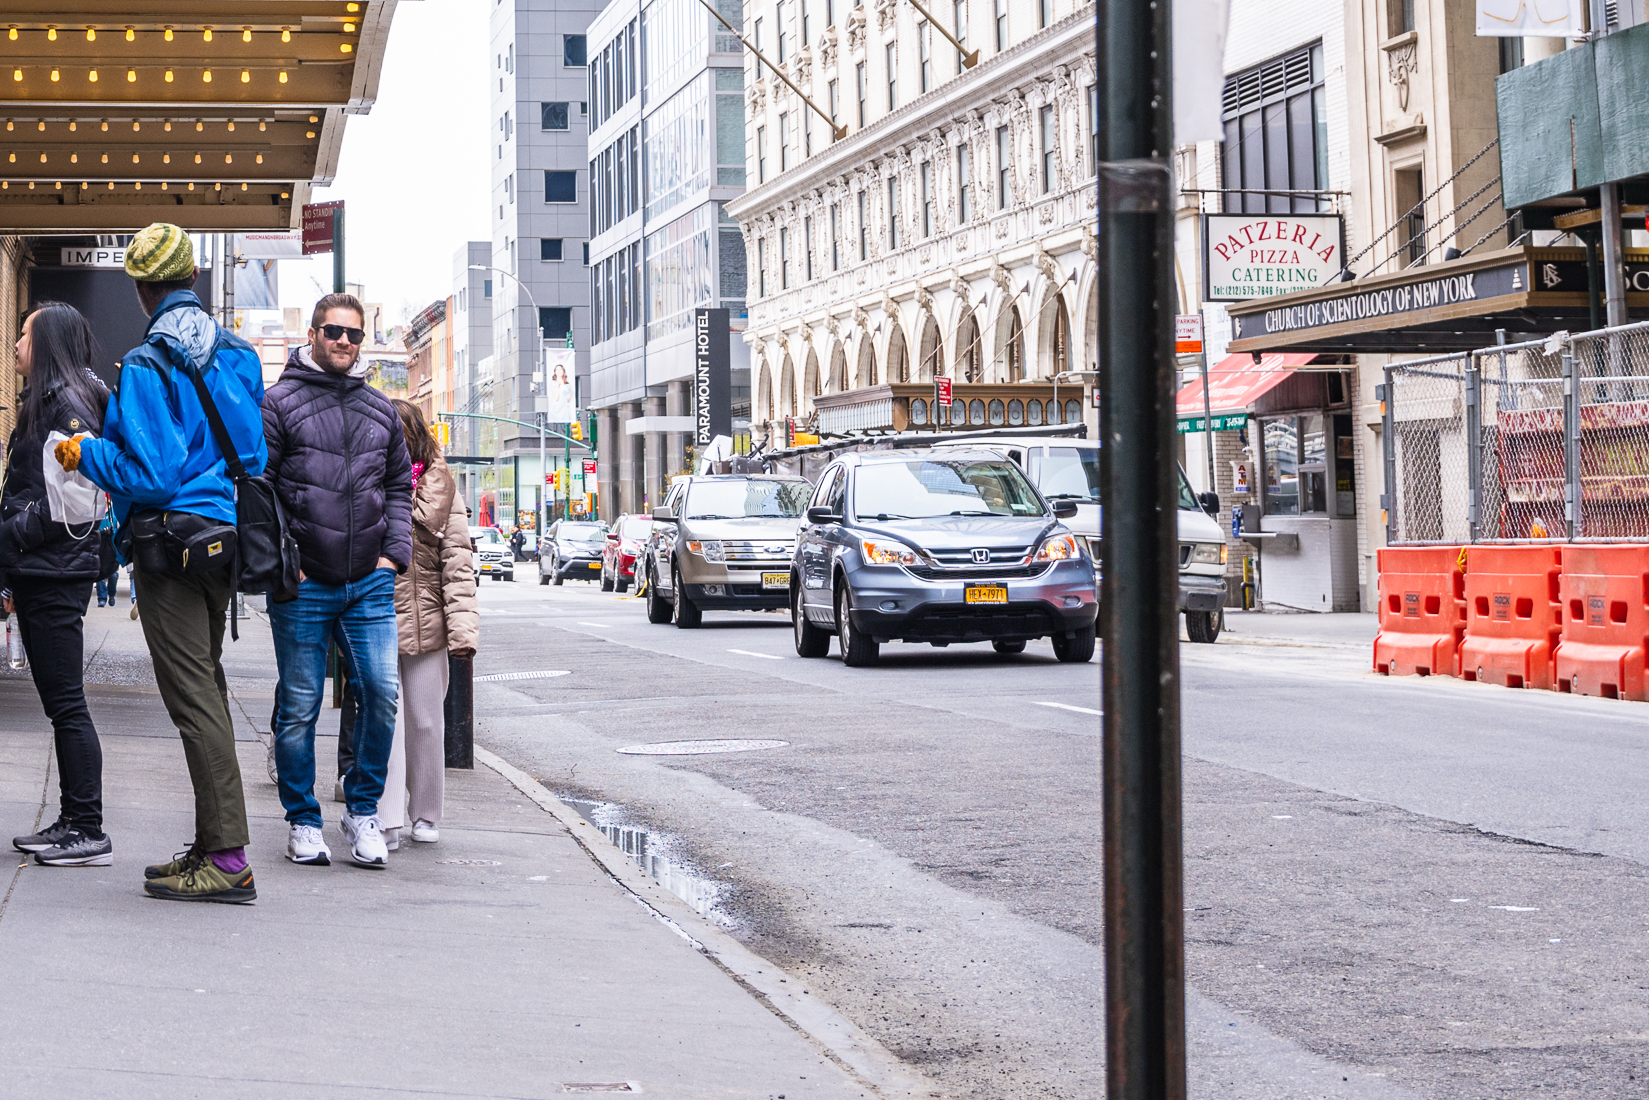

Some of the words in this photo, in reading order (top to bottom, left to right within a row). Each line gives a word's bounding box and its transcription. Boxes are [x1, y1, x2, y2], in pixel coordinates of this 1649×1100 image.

[304, 209, 311, 219] NO
[312, 207, 337, 218] STANDIN
[304, 220, 325, 231] Anytime
[1214, 220, 1335, 263] PATZERIA
[67, 251, 124, 263] IMPE
[1250, 249, 1300, 264] PIZZA
[1232, 267, 1318, 282] CATERING
[1265, 309, 1305, 333] CHURCH
[1307, 303, 1320, 325] OF
[1322, 289, 1393, 324] SCIENTOLOGY
[1396, 284, 1411, 311] OF
[1413, 279, 1441, 309] NEW
[1443, 273, 1477, 302] YORK
[697, 310, 710, 356] HOTEL
[698, 358, 711, 444] PARAMOUNT
